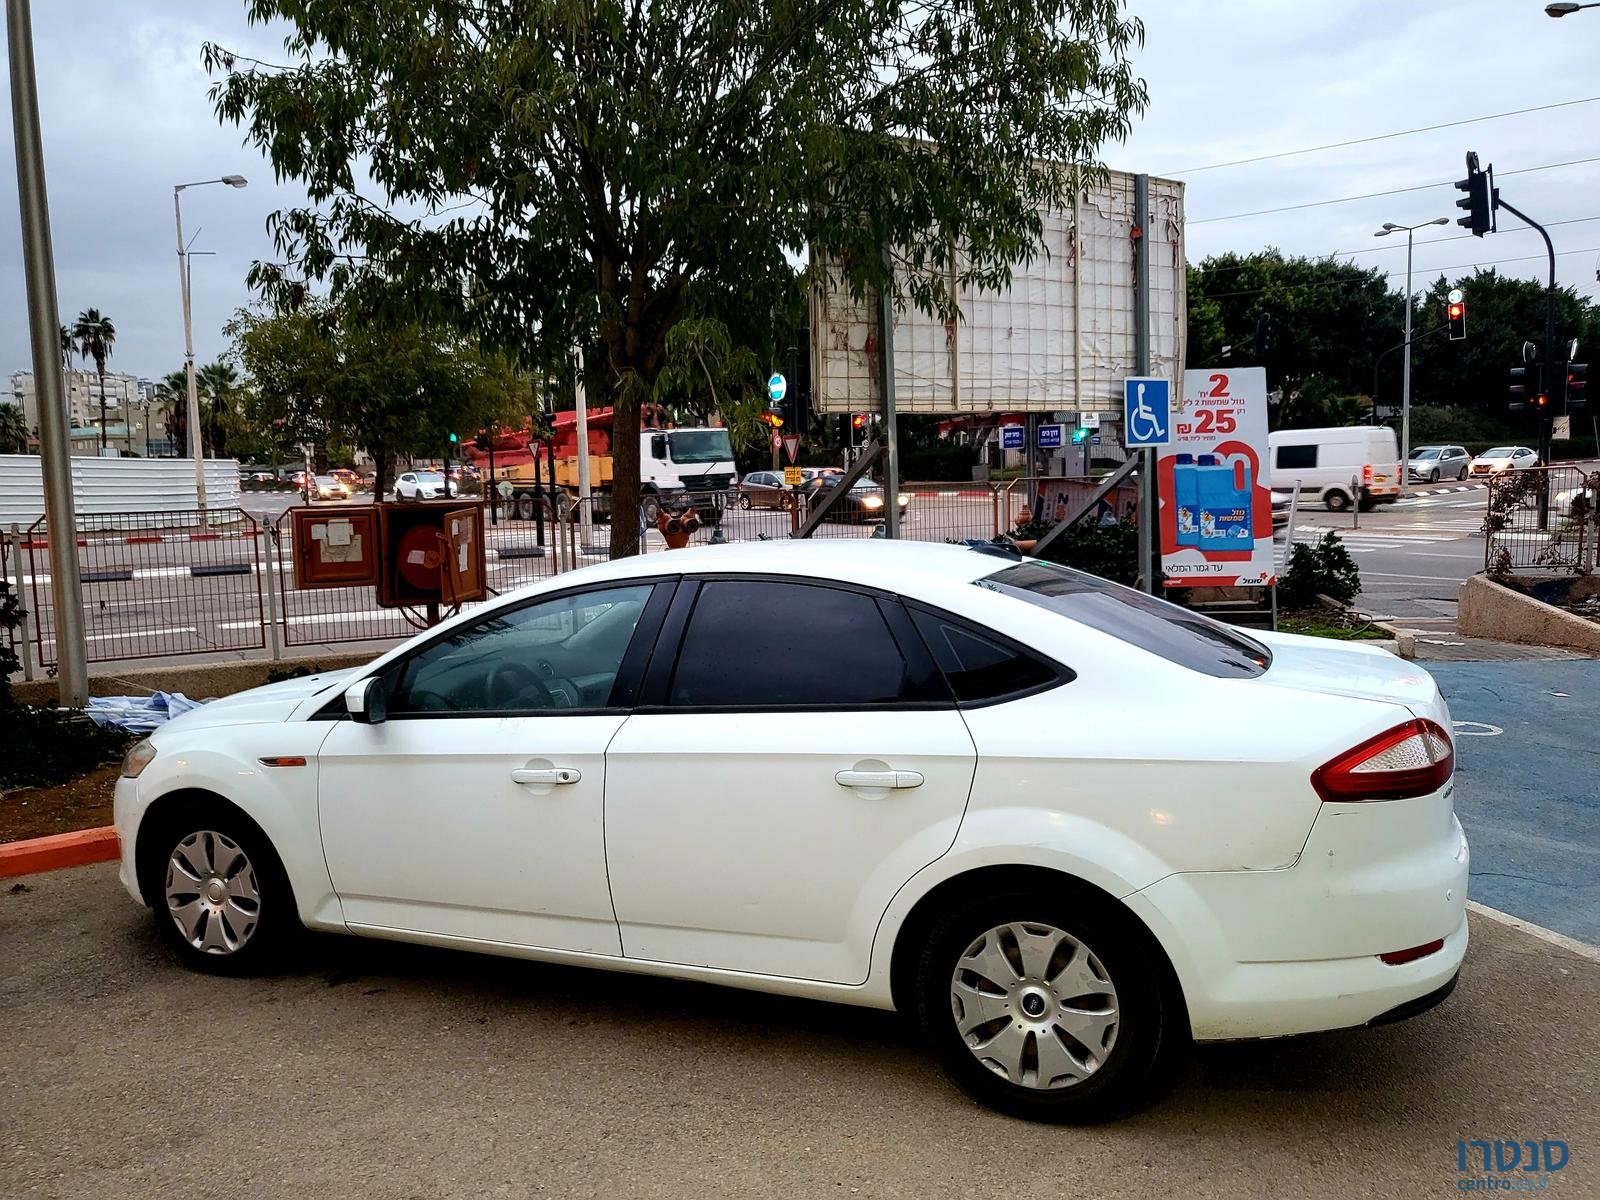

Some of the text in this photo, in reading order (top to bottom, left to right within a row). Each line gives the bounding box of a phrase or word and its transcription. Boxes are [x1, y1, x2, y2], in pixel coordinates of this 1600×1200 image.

[1209, 374, 1230, 397] 2
[1194, 409, 1237, 434] 25
[1165, 564, 1223, 573] עד גמר המלאי
